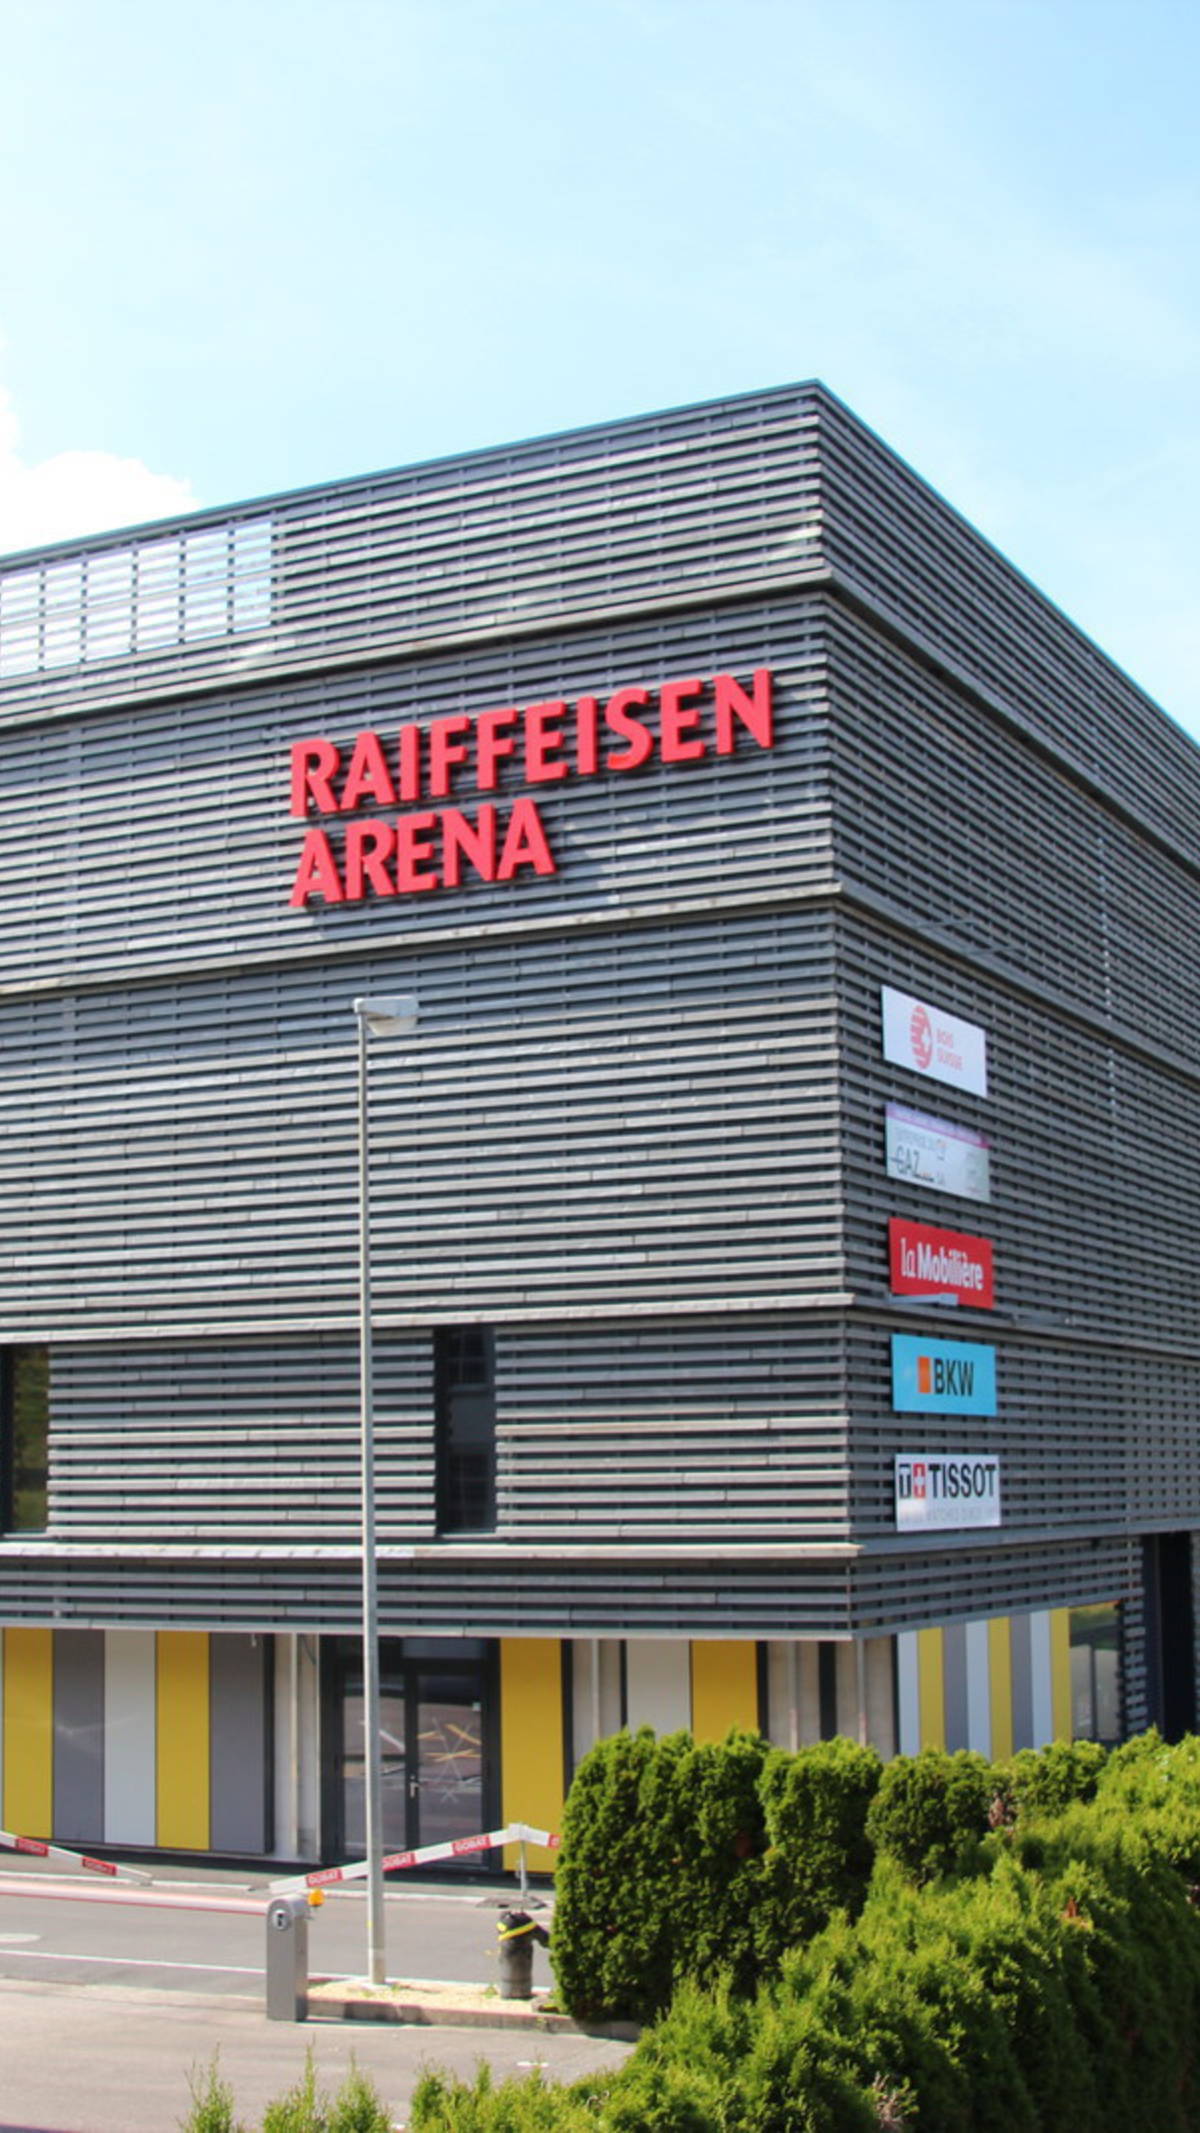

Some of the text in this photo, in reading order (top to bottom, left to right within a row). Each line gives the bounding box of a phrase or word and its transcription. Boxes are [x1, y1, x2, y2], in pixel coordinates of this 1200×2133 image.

[290, 668, 773, 817] RAIFFEISEN
[289, 797, 557, 907] ARENA
[900, 1237, 984, 1290] la Mobilière
[934, 1357, 974, 1397] BKW
[928, 1463, 996, 1499] TISSOT
